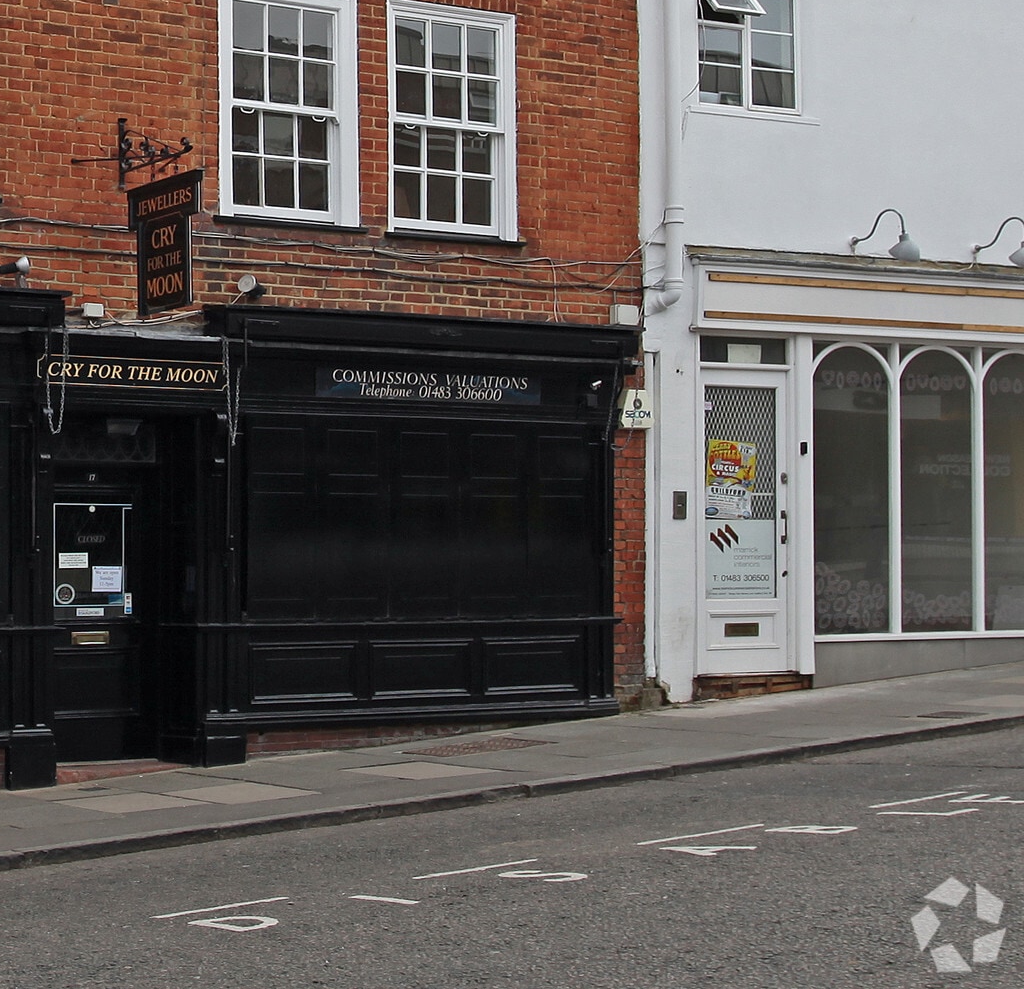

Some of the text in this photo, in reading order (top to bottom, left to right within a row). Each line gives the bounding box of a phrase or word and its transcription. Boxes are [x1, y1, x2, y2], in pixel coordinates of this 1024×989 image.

[137, 187, 193, 217] JEWELLERS
[151, 224, 177, 249] CRY
[147, 250, 182, 272] FOR THE
[146, 271, 184, 300] MOON
[48, 361, 219, 383] CRY FOR THE MOON
[332, 368, 529, 390] COMMISSIONS VALUATIONS
[418, 385, 452, 400] 01483
[455, 387, 503, 402] 306600
[625, 410, 651, 419] SECOM
[711, 463, 740, 473] CIRCUS
[743, 574, 770, 582] 306500
